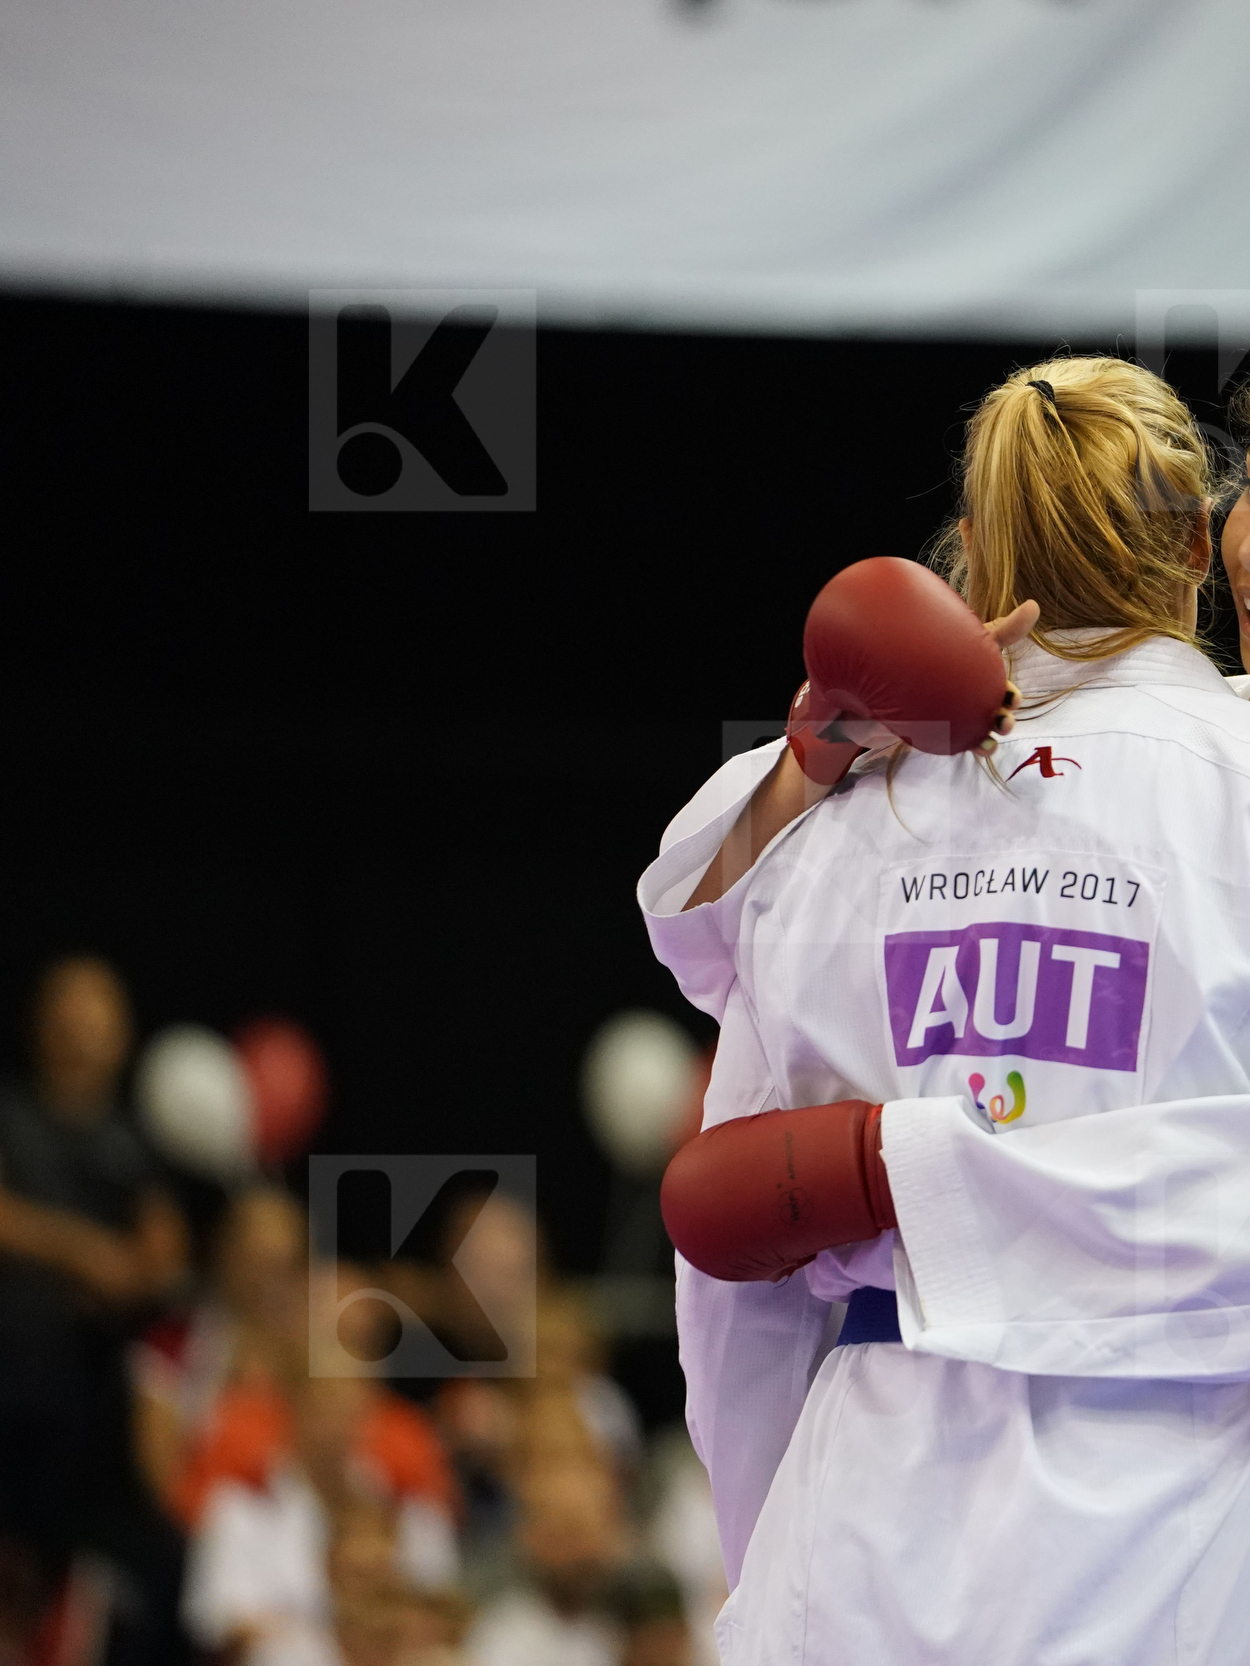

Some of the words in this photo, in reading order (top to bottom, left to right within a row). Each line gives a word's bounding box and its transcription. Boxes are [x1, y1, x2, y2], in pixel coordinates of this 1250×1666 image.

[901, 867, 1049, 903] WROCŁAW
[1060, 871, 1140, 907] 2017
[906, 937, 1120, 1050] AUT
